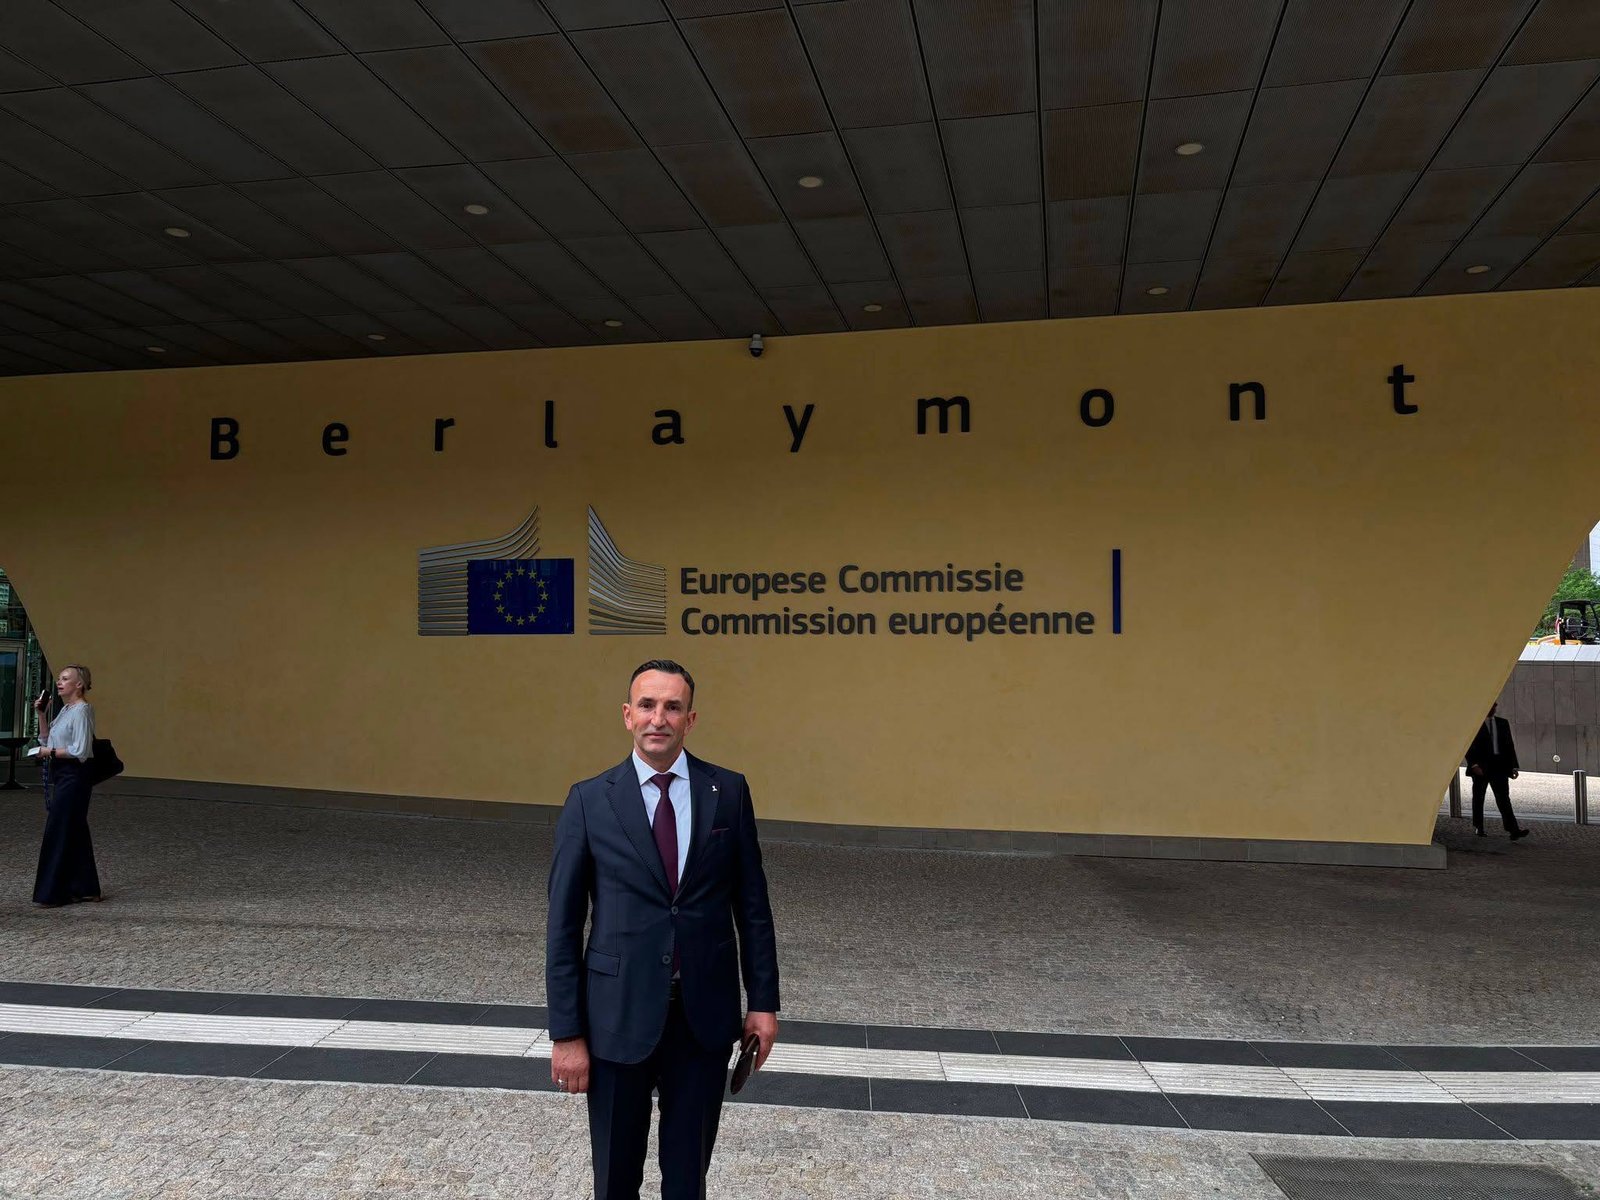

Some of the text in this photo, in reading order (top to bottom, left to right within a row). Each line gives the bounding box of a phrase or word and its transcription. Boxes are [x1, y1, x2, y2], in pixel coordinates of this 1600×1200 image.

[211, 364, 1418, 460] Berlaymont
[681, 562, 1024, 601] Europese Commissie
[681, 603, 1095, 642] Commission européenne
